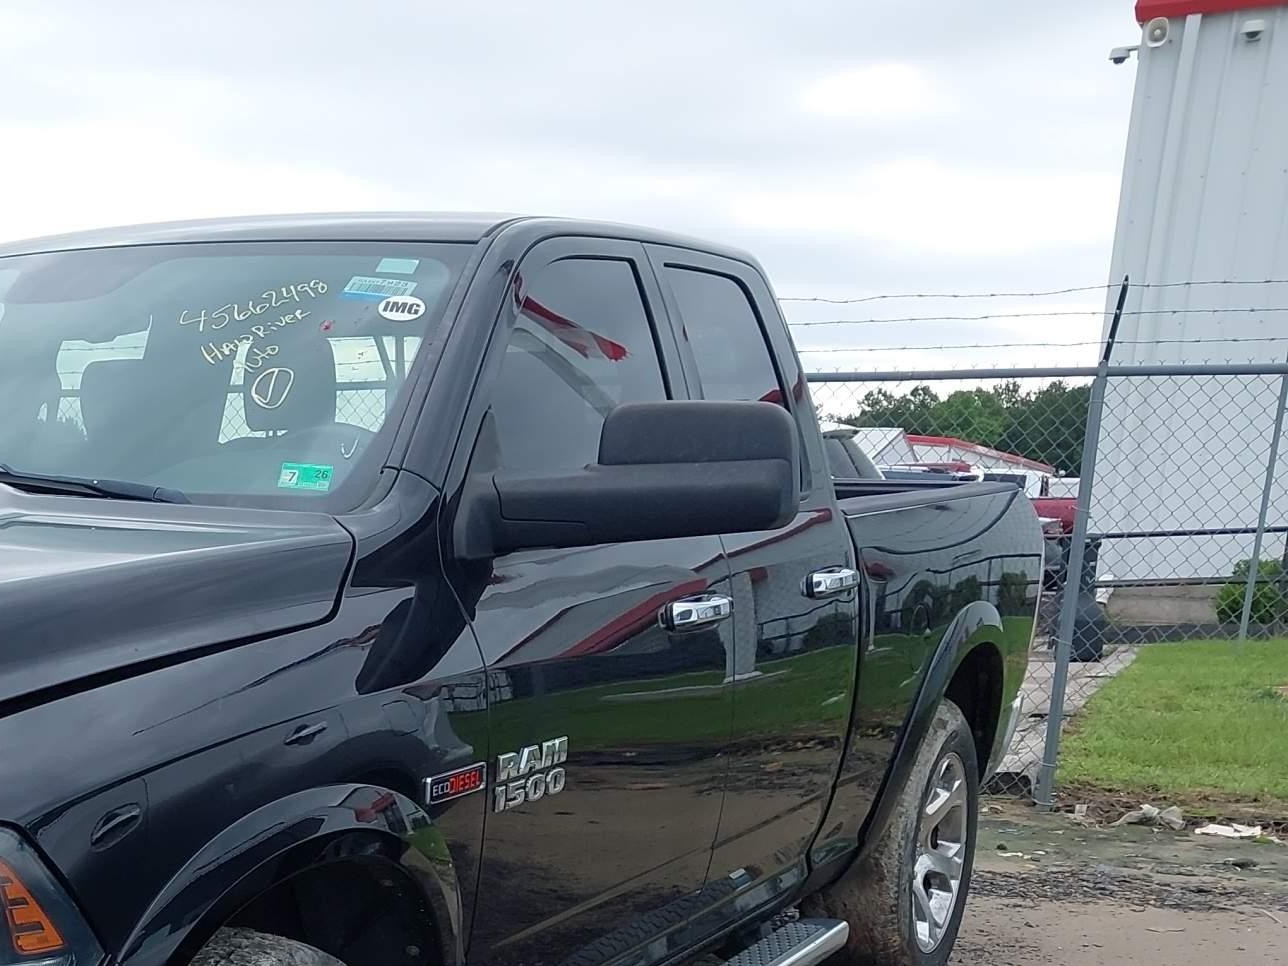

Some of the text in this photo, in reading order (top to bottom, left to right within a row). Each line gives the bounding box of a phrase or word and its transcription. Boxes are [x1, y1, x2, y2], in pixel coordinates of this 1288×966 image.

[179, 280, 328, 332] 45662498
[382, 301, 421, 315] IMG
[288, 469, 329, 482] 7 26
[496, 735, 569, 783] RAM
[432, 769, 481, 797] ECODIESEL
[494, 767, 566, 813] 1500
